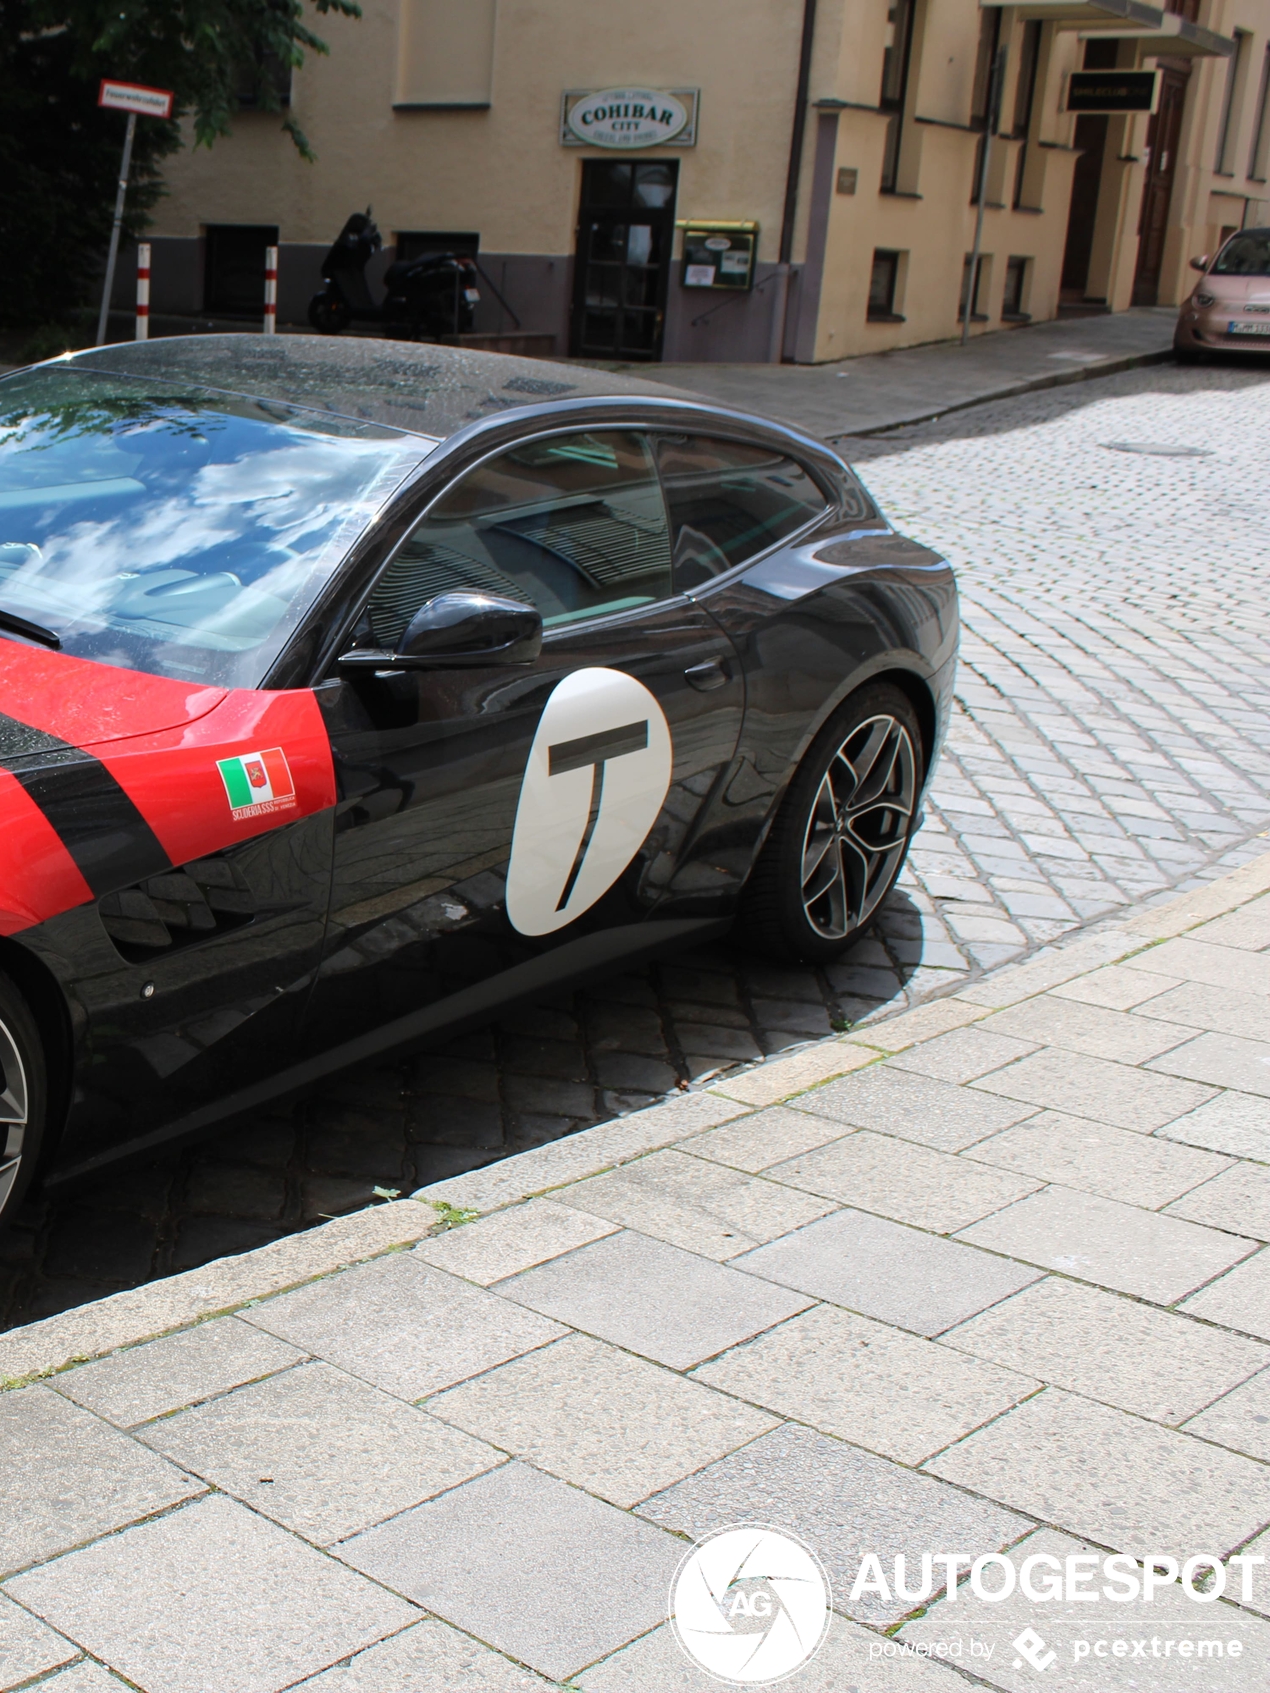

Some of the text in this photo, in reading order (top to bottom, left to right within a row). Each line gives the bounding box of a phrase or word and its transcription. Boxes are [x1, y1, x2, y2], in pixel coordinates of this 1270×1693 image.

[582, 104, 673, 125] COHIBAR
[611, 121, 641, 131] CITY
[232, 801, 275, 821] SCUDERIA SSS
[548, 719, 649, 912] T
